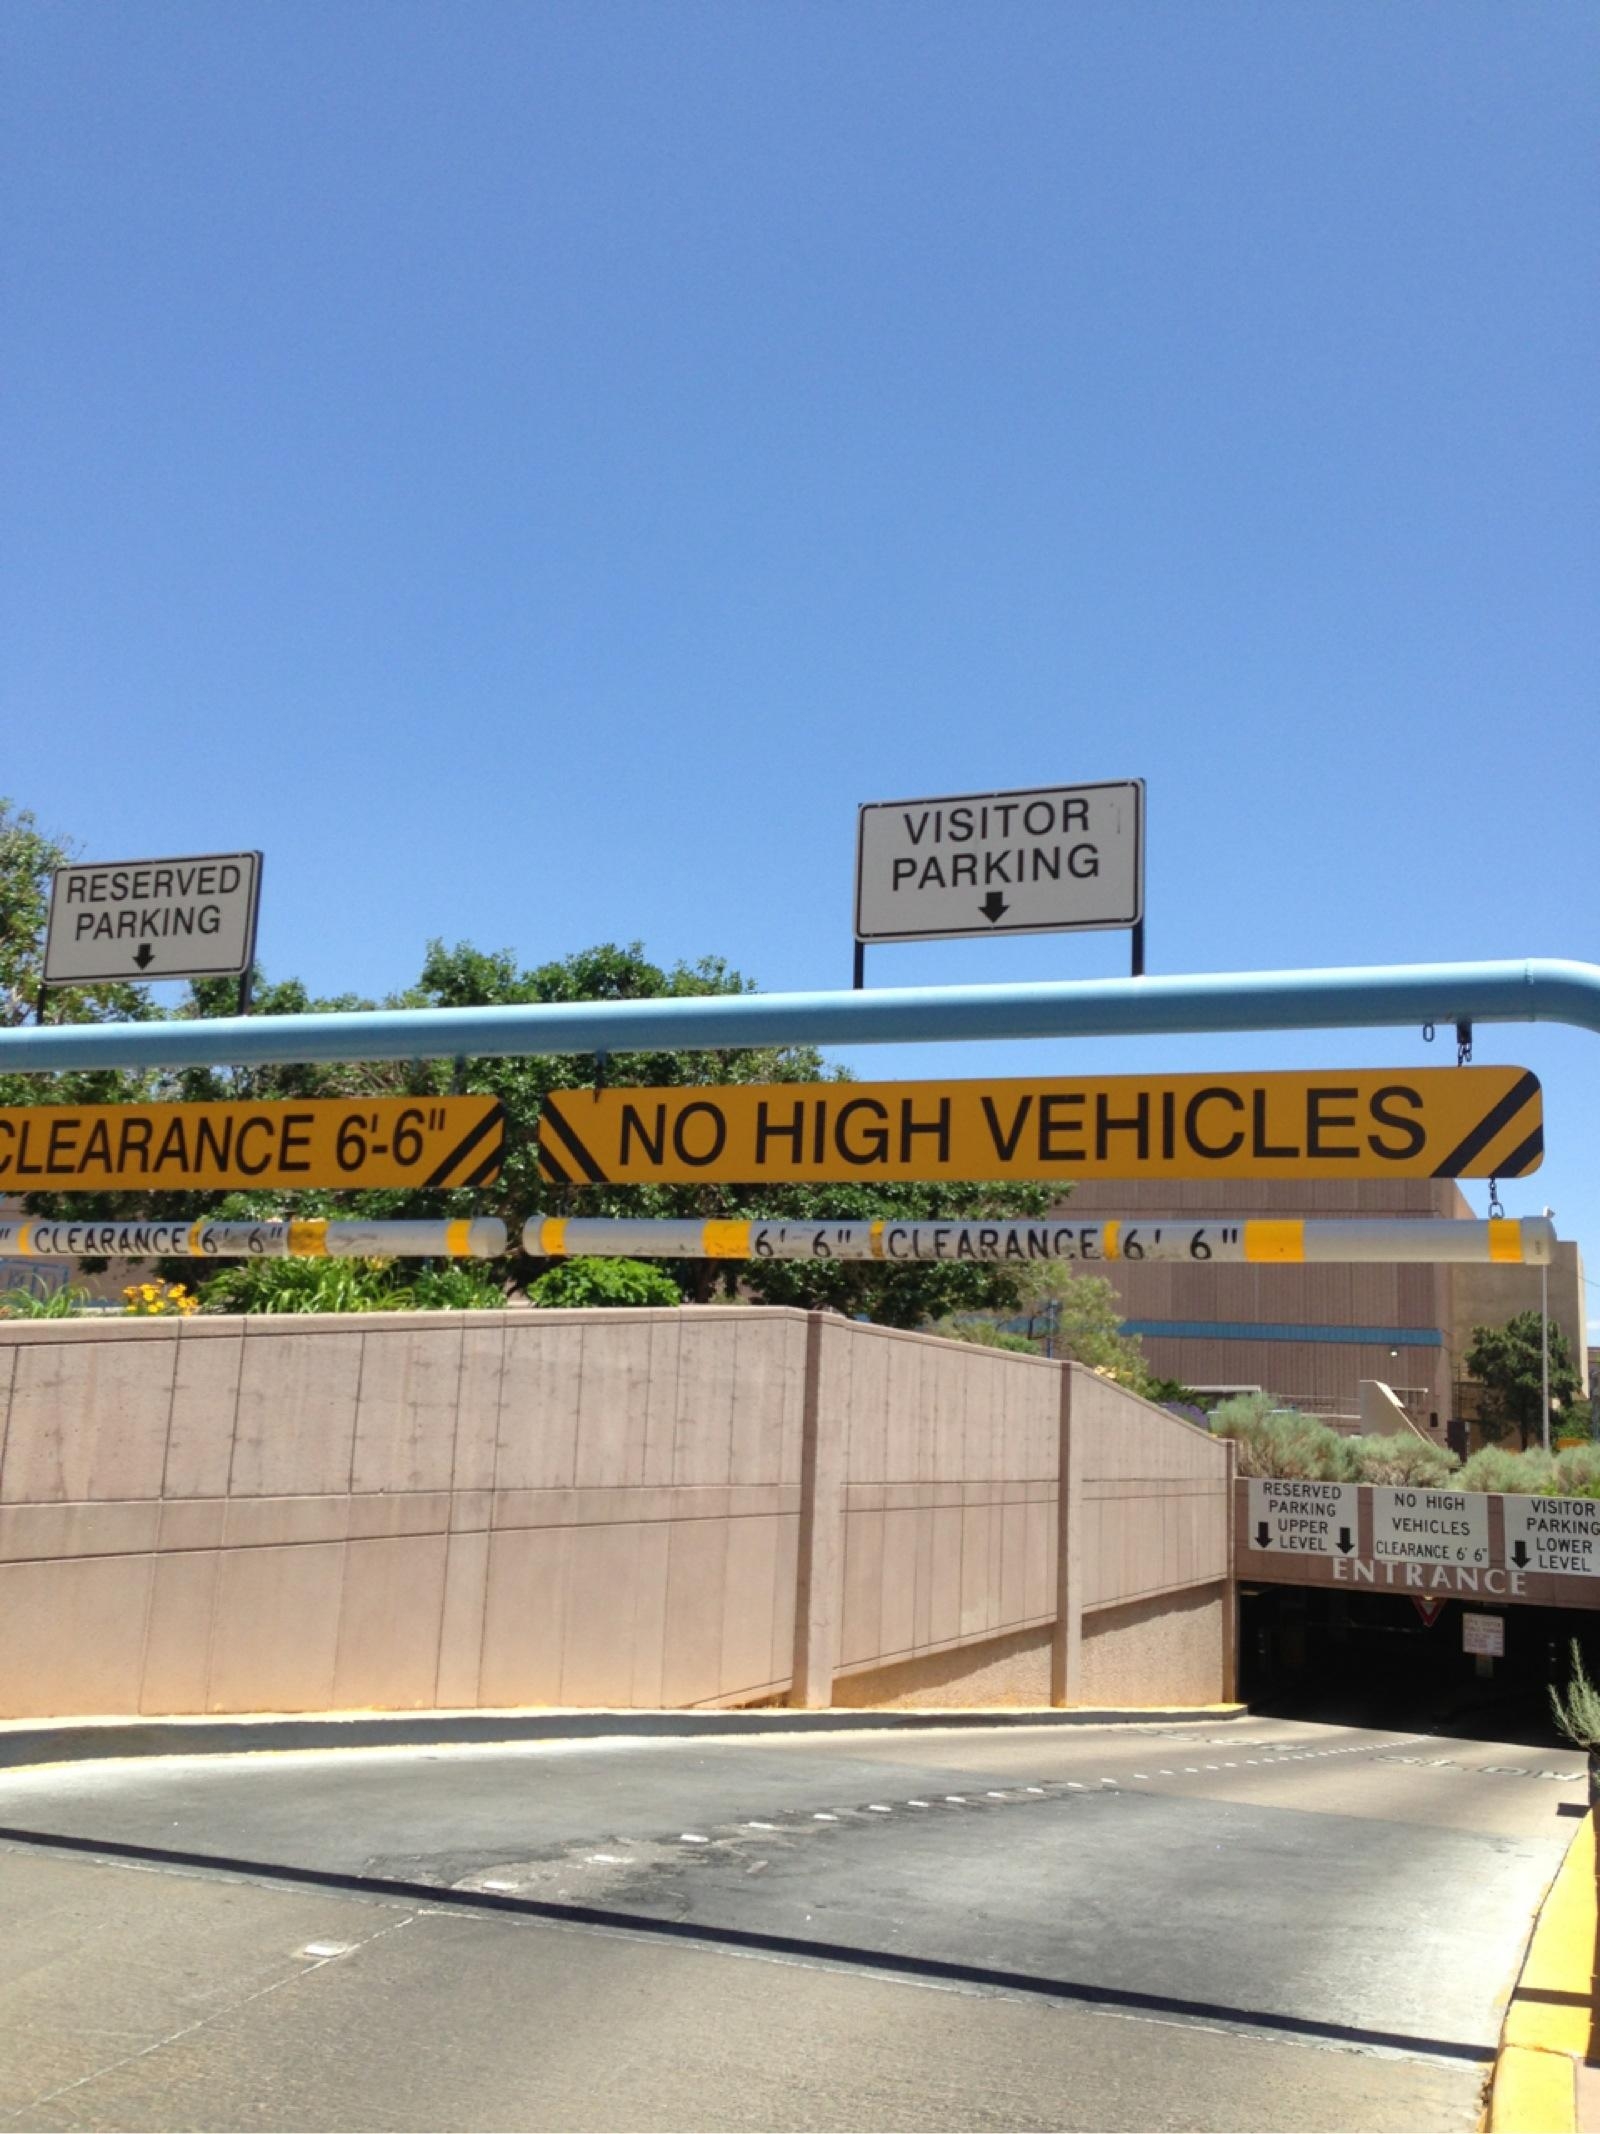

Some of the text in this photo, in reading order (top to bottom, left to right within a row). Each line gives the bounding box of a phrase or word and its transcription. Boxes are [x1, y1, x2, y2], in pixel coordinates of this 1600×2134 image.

[904, 797, 1090, 846] VISITOR
[893, 844, 1099, 891] PARKING
[67, 864, 241, 903] RESERVED
[75, 905, 220, 941] PARKING
[619, 1086, 1426, 1167] NO HIGH VEHICLES
[336, 1107, 446, 1172] 6'-6"
[34, 1227, 187, 1254] CLEARANCE
[887, 1226, 1099, 1261] CLEARANCE
[1263, 1482, 1342, 1500] RESERVED
[1269, 1499, 1336, 1517] PARKING
[1394, 1493, 1465, 1512] NO HIGH
[1531, 1499, 1595, 1517] VISITOR
[1277, 1518, 1329, 1534] UPPER
[1391, 1517, 1471, 1536] VEHICLES
[1526, 1517, 1600, 1536] PARKING
[1280, 1534, 1327, 1551] LEVEL
[1375, 1540, 1450, 1560] CLEARANCE
[1536, 1537, 1592, 1554] LOWER
[1539, 1554, 1593, 1573] LEVEL
[1332, 1557, 1527, 1596] ENTRANCE
